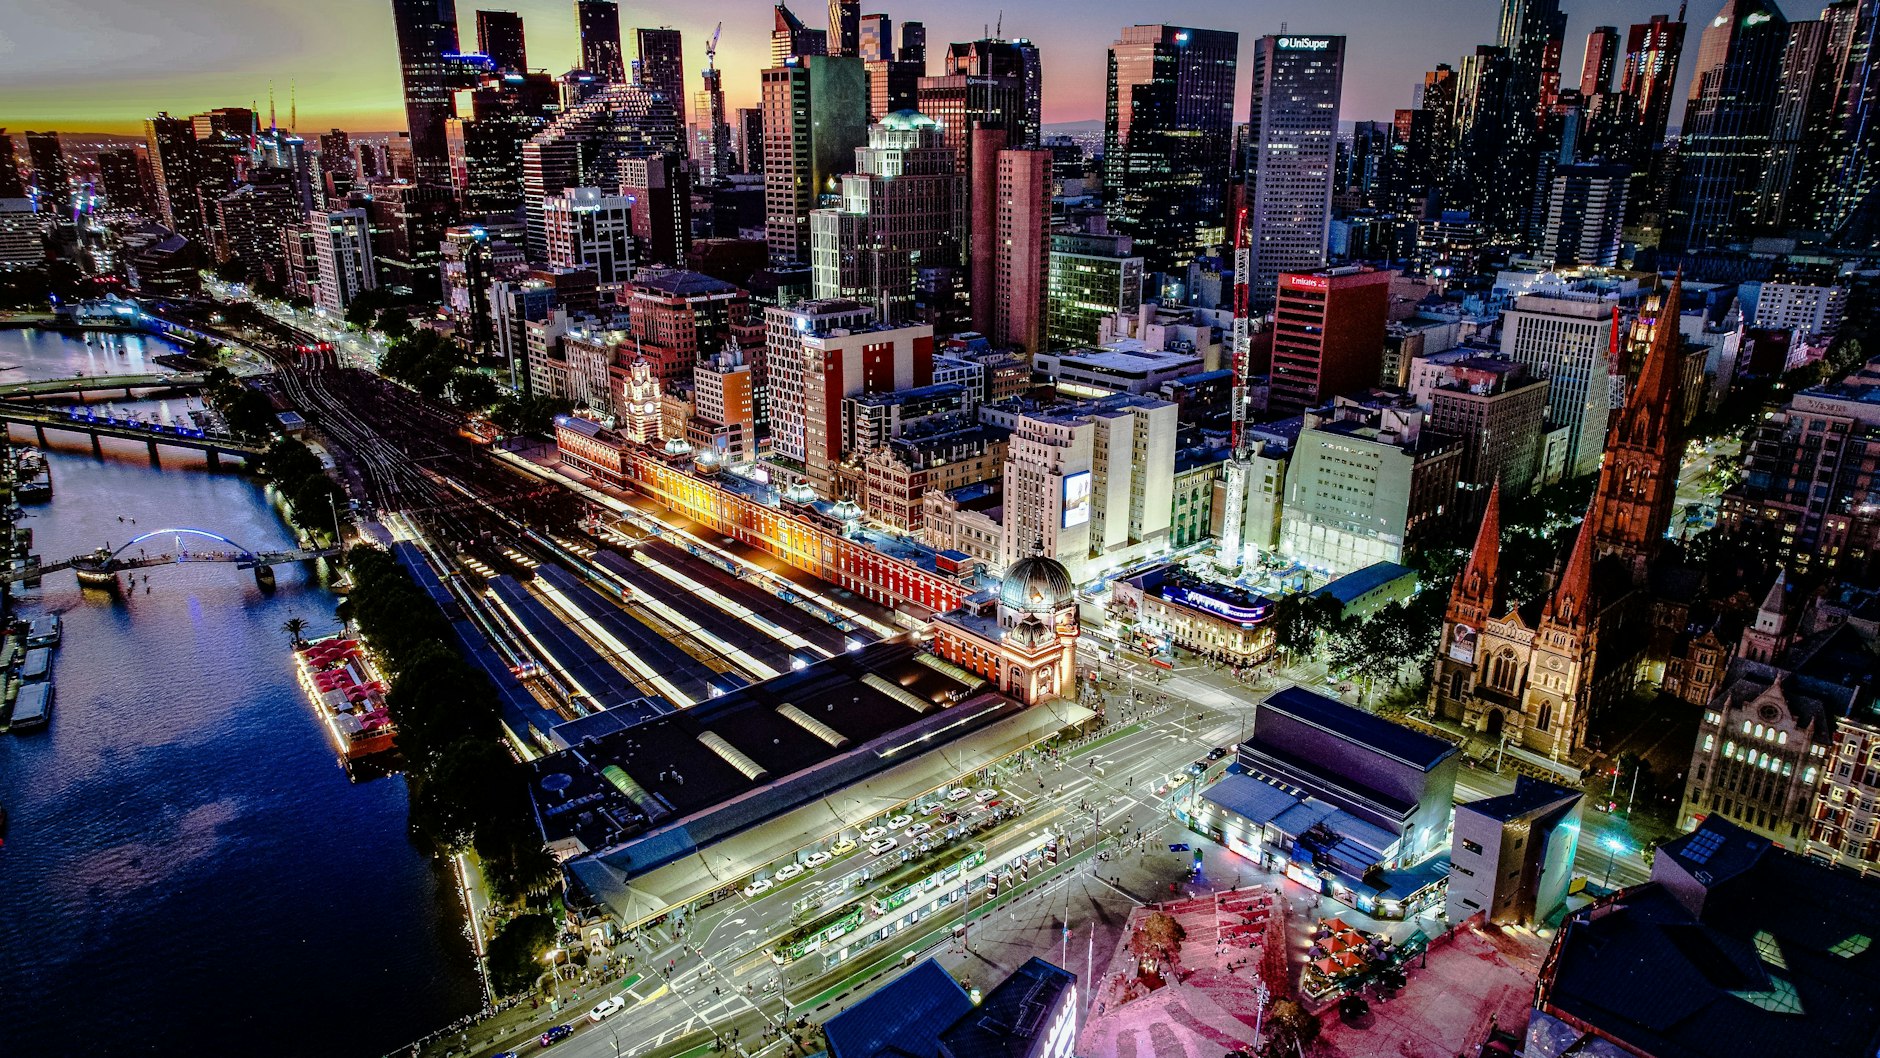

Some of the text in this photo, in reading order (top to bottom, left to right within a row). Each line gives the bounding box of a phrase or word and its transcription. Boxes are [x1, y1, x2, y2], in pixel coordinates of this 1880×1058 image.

[1289, 37, 1329, 51] UniSuper
[1291, 276, 1317, 287] Emirates
[684, 292, 737, 303] VICTORIA UNIVERSITY
[1226, 608, 1257, 618] UCCESSION
